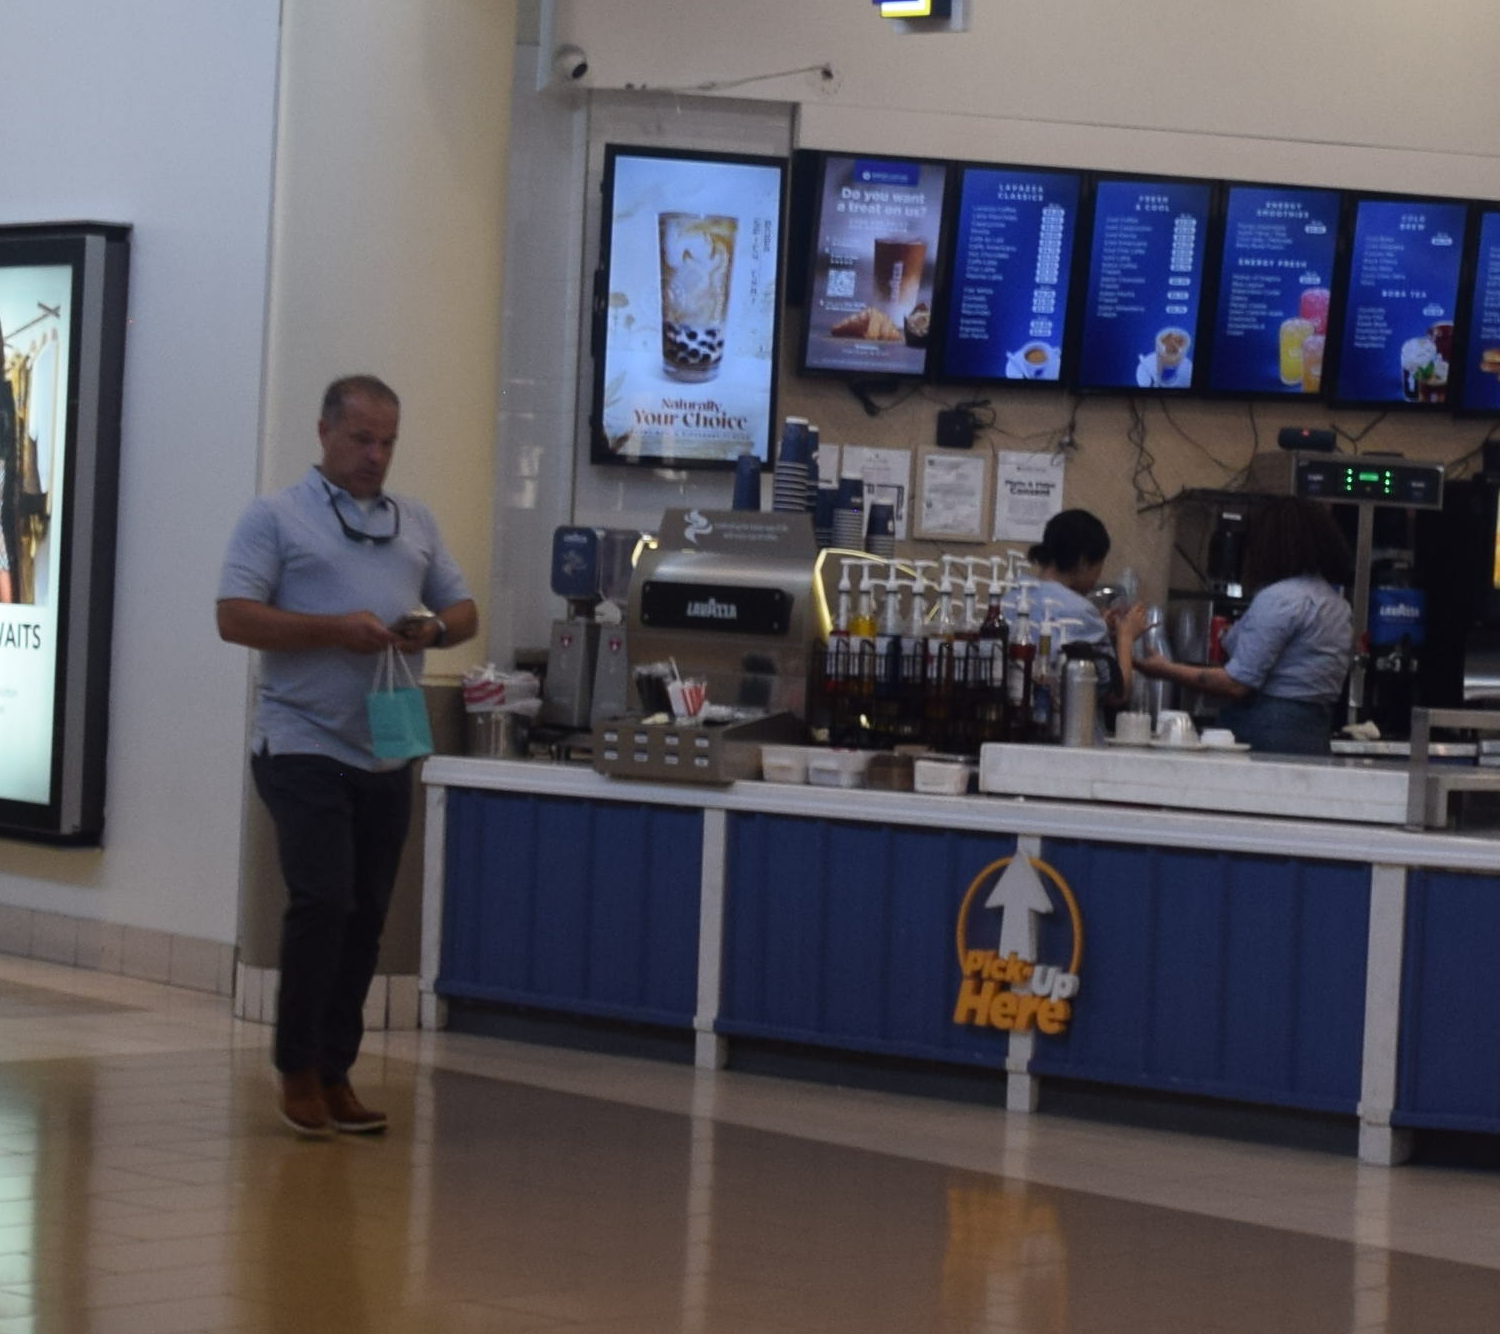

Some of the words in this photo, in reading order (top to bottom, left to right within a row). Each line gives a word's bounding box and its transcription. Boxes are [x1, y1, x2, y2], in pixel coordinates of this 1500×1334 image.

[841, 186, 861, 200] Do
[863, 190, 889, 203] you
[892, 192, 925, 204] want
[998, 192, 1044, 202] CLASSICS
[848, 201, 881, 214] treat
[884, 205, 901, 216] on
[904, 205, 927, 217] us?
[1145, 204, 1170, 212] COOL
[1238, 258, 1275, 267] ENERGY
[661, 397, 722, 414] Naturally
[634, 409, 679, 426] Your
[682, 411, 748, 431] Choice
[686, 596, 738, 620] LAVAZZA
[953, 978, 1073, 1036] Here
